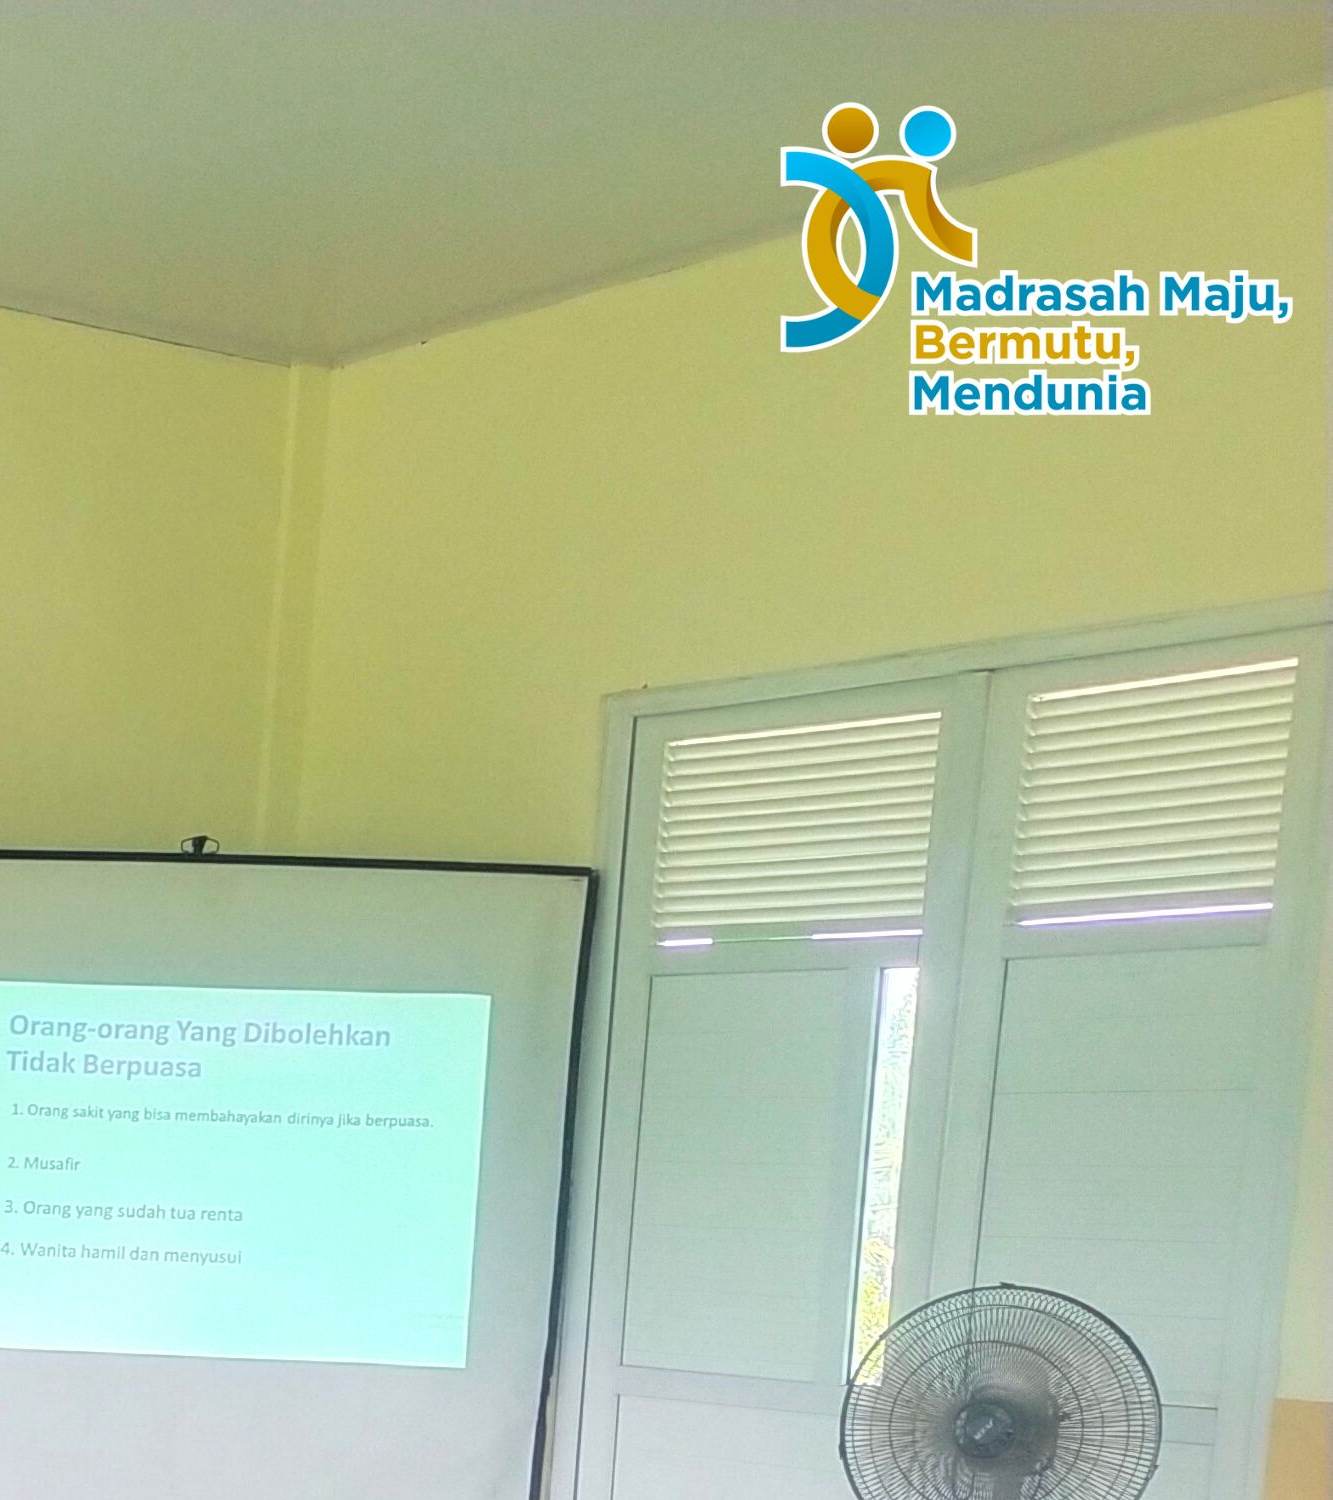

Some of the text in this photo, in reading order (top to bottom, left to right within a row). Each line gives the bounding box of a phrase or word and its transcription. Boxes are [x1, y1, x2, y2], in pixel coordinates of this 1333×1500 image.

[8, 1014, 391, 1048] Orang-orang Yang Dibolehkan
[6, 1049, 203, 1081] Tidak Berpuasa
[11, 1104, 24, 1116] 1.
[27, 1104, 69, 1120] Orang
[72, 1105, 104, 1119] sakit
[107, 1108, 140, 1122] yang
[144, 1107, 171, 1121] bisa
[175, 1110, 282, 1126] membahayakan
[287, 1112, 334, 1128] dirinya
[365, 1113, 435, 1130] berpuasa.
[7, 1156, 81, 1172] 2. Musafir
[4, 1200, 244, 1223] 3. Orang yang sudah tua renta
[0, 1241, 242, 1267] 4. Wanita hamil dan menyusui
